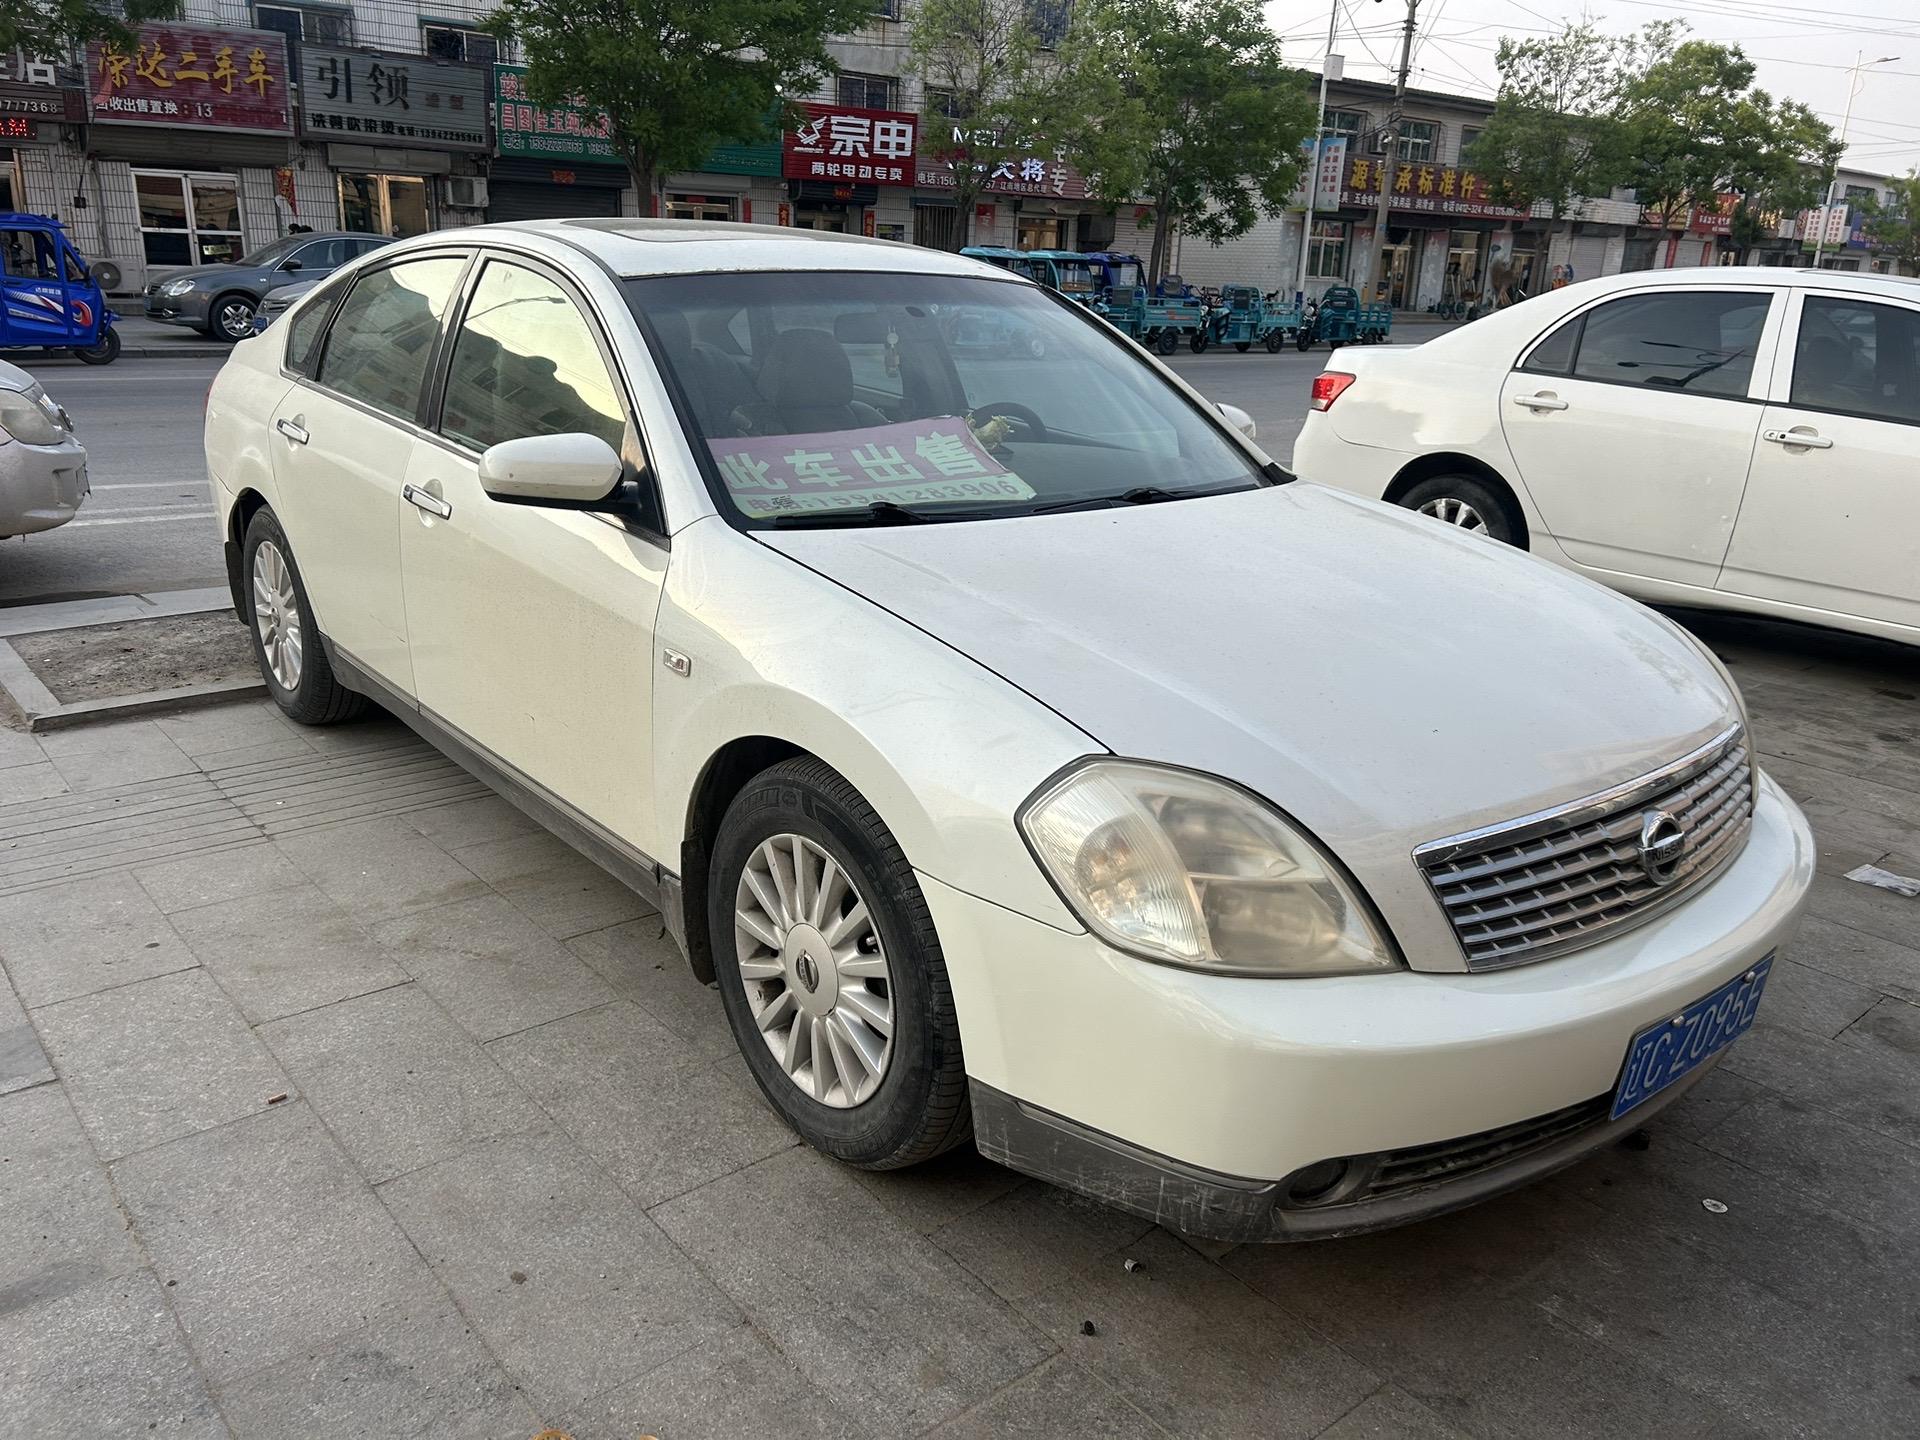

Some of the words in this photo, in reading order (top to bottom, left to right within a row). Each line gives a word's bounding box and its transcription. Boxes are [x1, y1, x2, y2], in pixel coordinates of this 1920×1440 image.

[318, 57, 411, 110] 引领
[0, 99, 58, 114] 777368
[829, 115, 913, 159] 宗申
[811, 161, 903, 181] 两轮电动专卖
[718, 430, 987, 491] 此车出售
